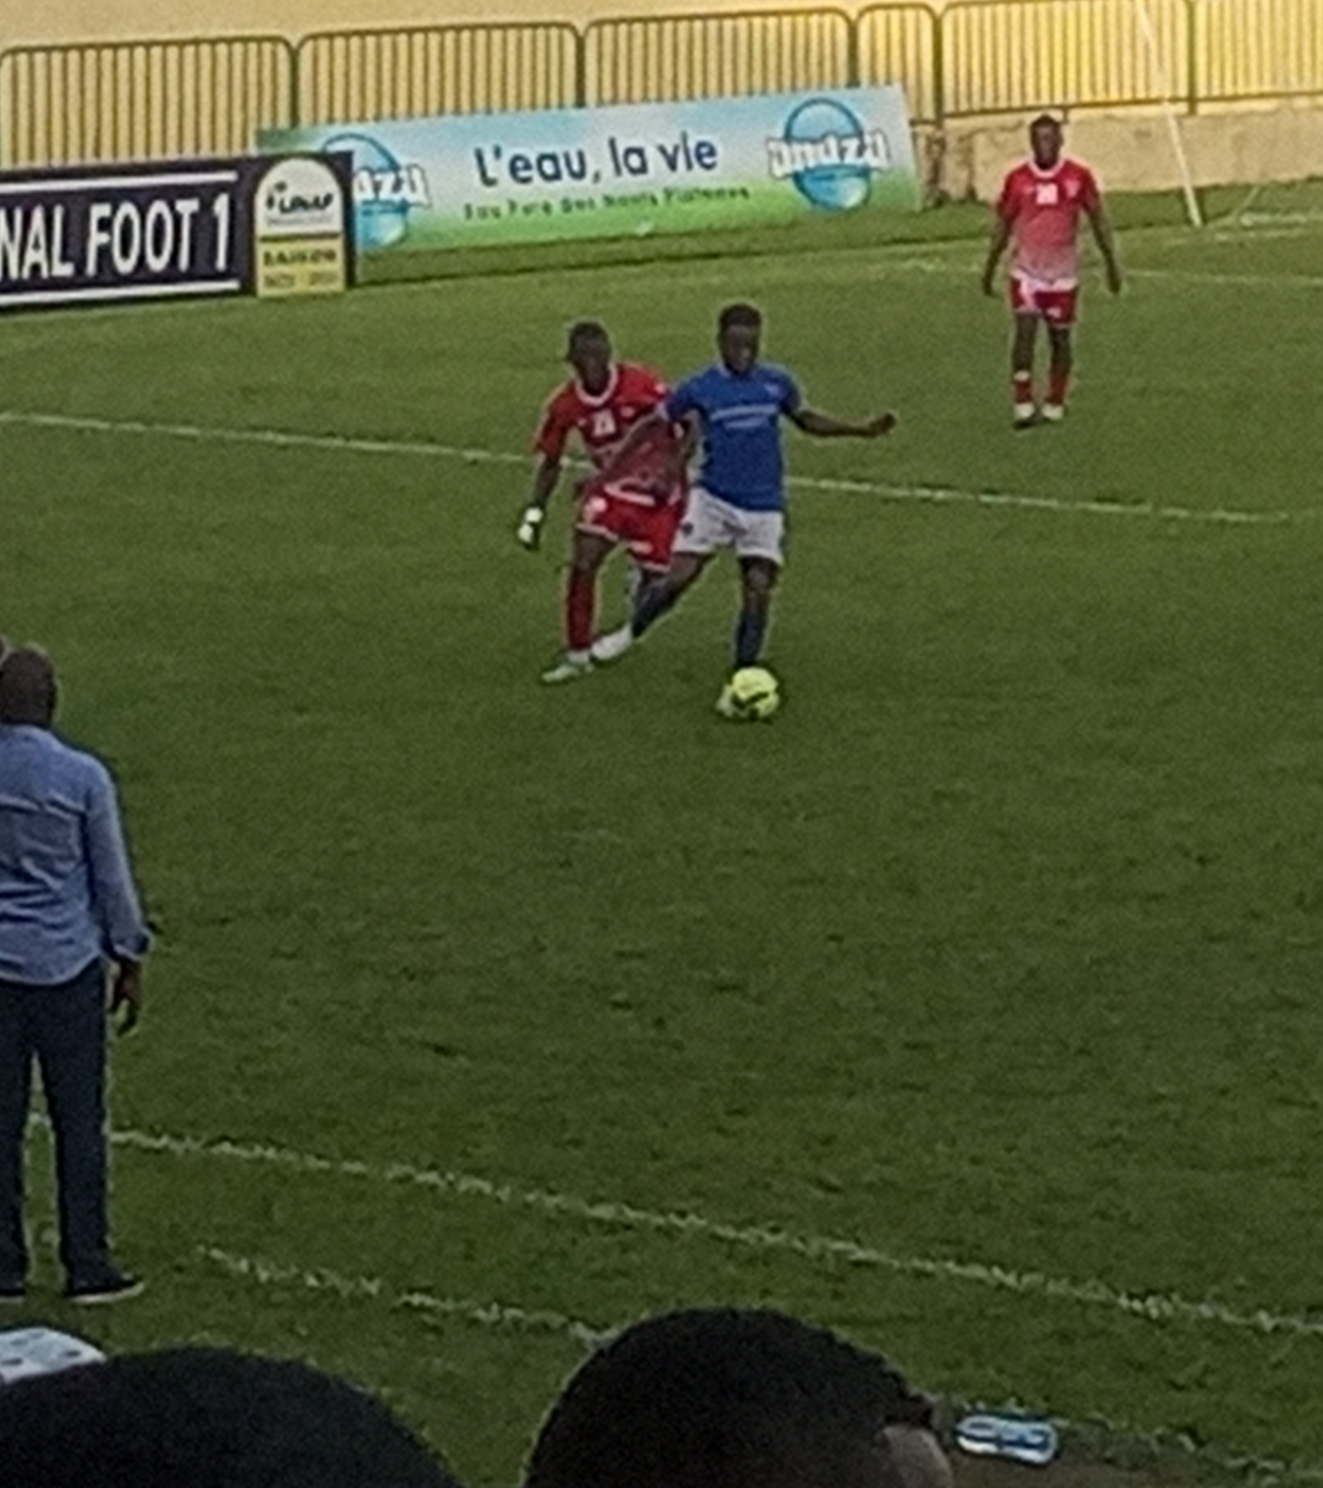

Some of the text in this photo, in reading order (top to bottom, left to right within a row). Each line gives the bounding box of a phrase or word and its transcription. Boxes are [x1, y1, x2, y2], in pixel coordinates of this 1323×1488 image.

[474, 130, 718, 188] L'eau, la vie
[0, 192, 230, 280] NAL FOOT 1
